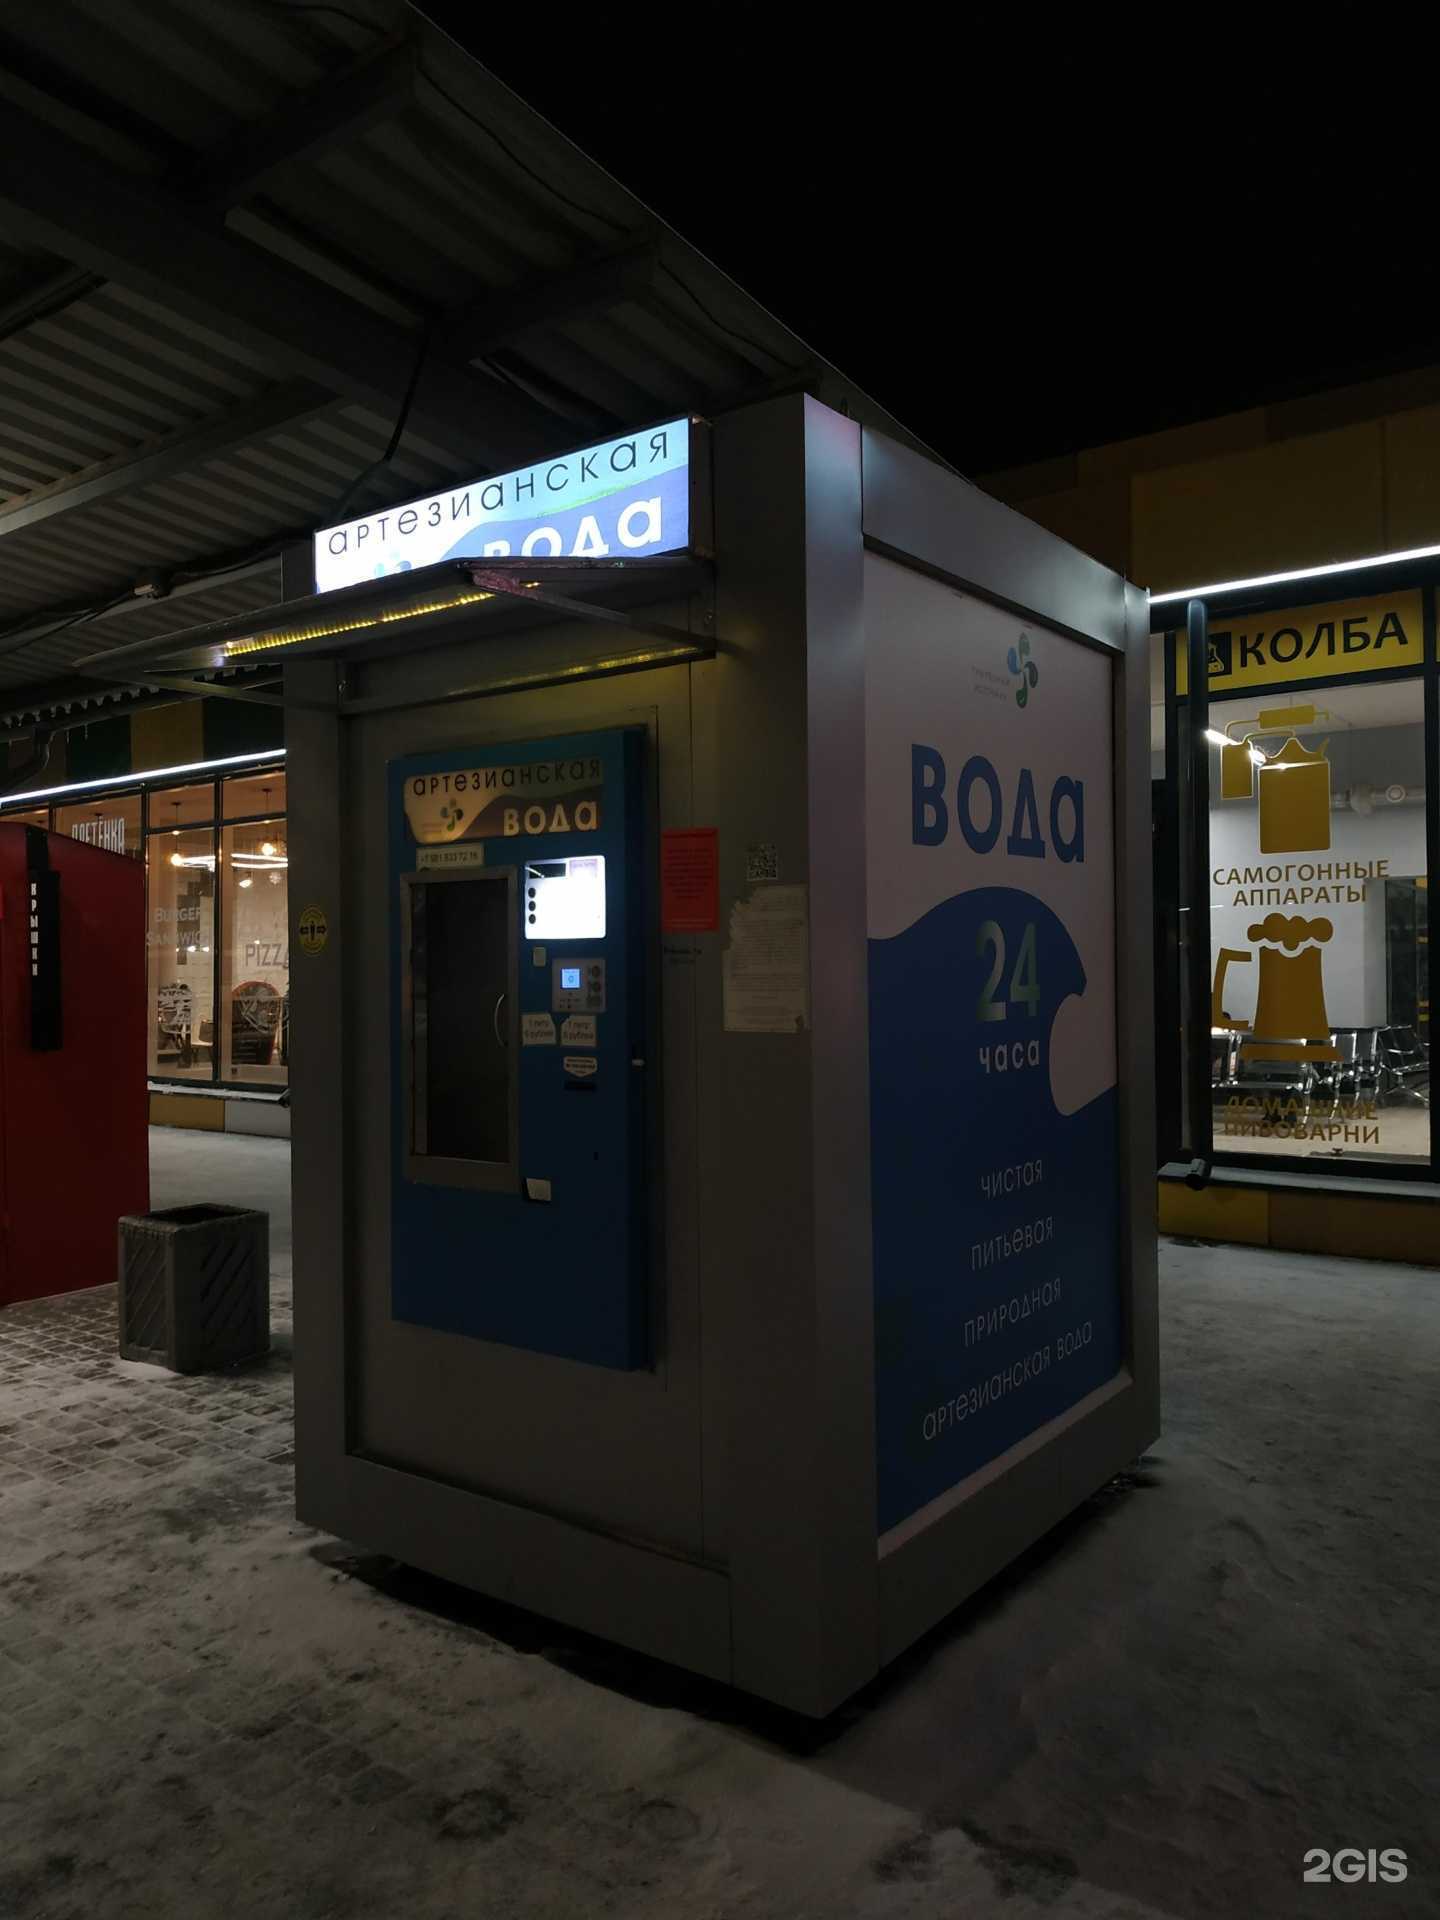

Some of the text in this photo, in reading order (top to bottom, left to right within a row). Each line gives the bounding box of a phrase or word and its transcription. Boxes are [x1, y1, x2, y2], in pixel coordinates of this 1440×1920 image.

[329, 431, 669, 555] артезианская
[1239, 612, 1408, 668] КОЛБА
[413, 760, 600, 796] артезианская
[1213, 860, 1390, 886] САМОГОННЫЕ
[1233, 884, 1367, 907] АППАРАТЫ
[976, 919, 1041, 1022] 24
[979, 1039, 1041, 1074] часа
[979, 1159, 1043, 1200] чистая
[969, 1216, 1054, 1271] питьевая
[963, 1277, 1062, 1348] природная
[922, 1345, 1051, 1440] артезианская
